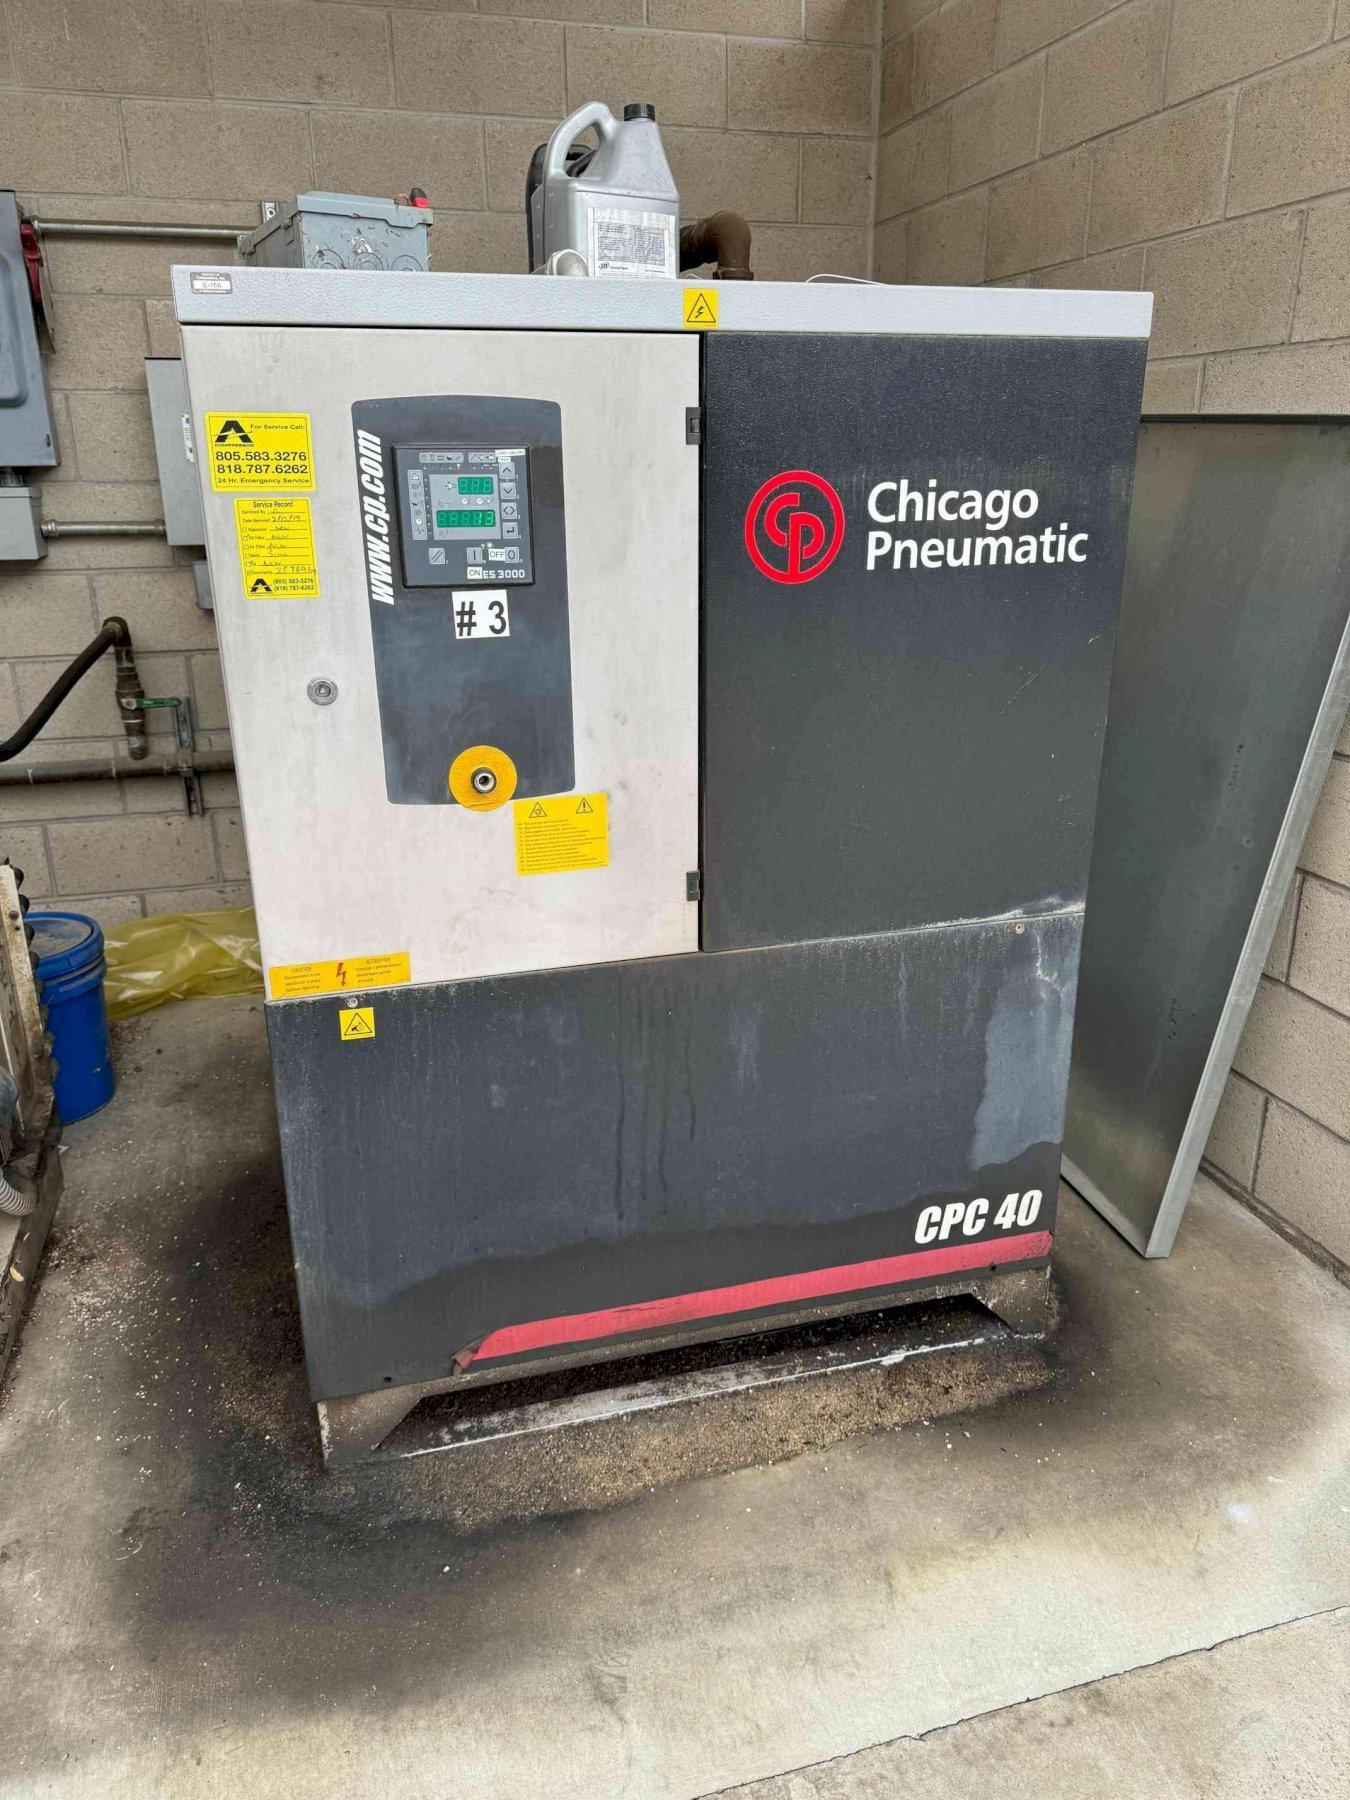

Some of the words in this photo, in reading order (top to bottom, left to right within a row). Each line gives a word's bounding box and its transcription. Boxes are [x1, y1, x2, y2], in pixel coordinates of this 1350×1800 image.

[216, 451, 307, 461] 805.583.3276
[216, 464, 308, 474] 818.787.6262
[253, 501, 273, 509] Service
[867, 479, 1039, 531] Chicago
[357, 429, 395, 605] www.cp.com
[867, 522, 1089, 571] Pneumatic
[489, 550, 505, 558] OFF
[497, 569, 525, 579] 3000
[914, 1198, 989, 1244] CPC
[993, 1189, 1043, 1230] 40
